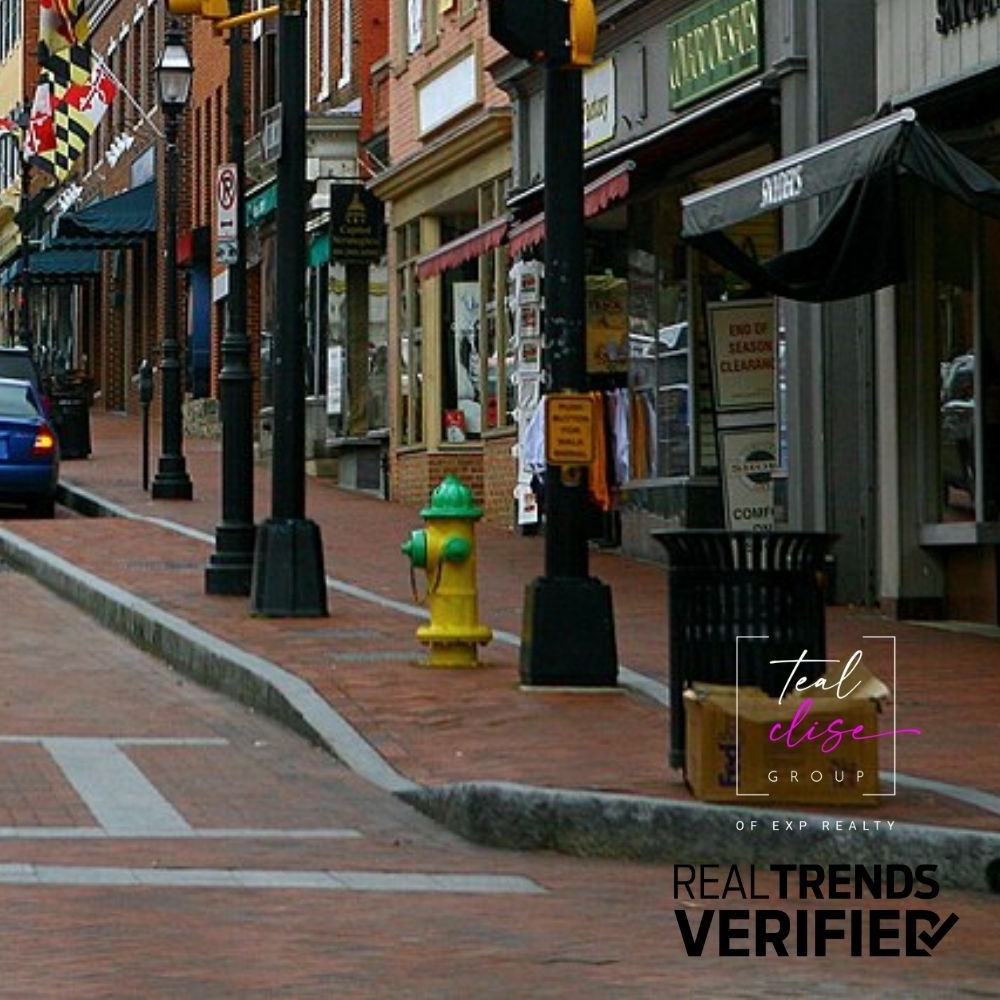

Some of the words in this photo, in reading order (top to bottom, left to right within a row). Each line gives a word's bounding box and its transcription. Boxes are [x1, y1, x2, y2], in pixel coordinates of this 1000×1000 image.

[729, 323, 751, 336] END
[755, 322, 768, 335] OF
[729, 341, 774, 355] SEASON
